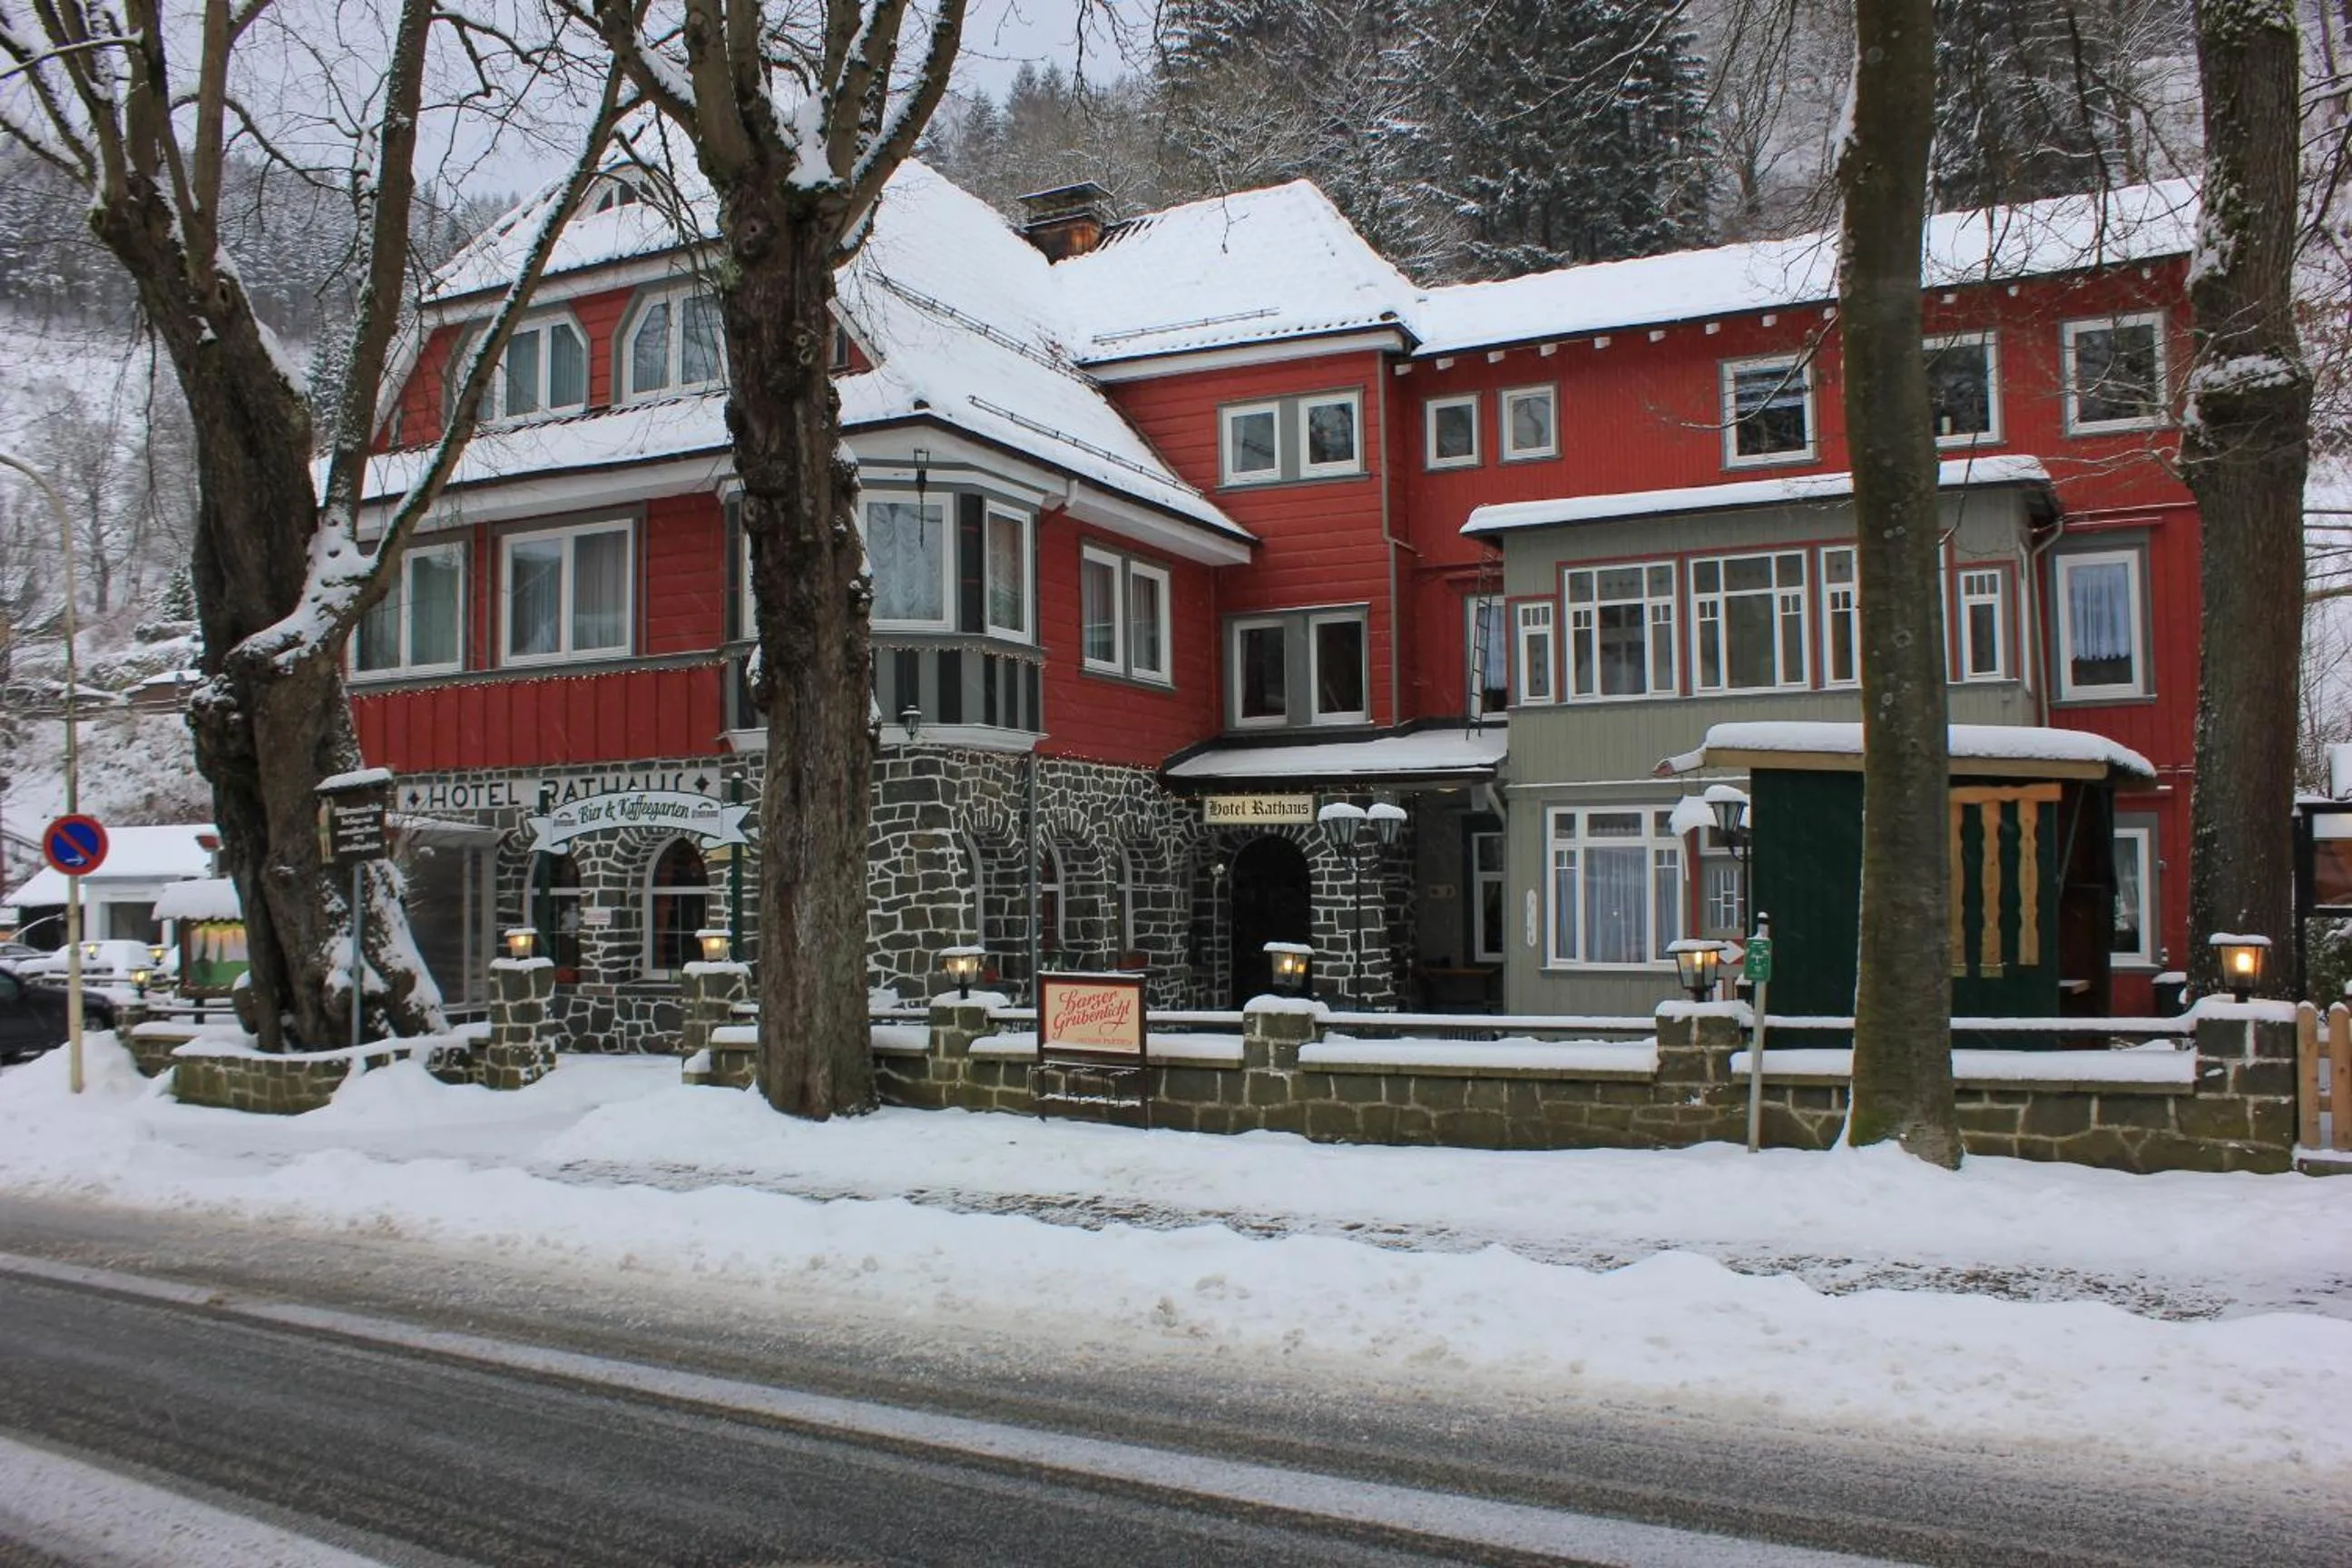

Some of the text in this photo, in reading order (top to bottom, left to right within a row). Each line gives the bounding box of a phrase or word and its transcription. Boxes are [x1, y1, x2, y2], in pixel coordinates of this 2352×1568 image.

[429, 781, 520, 808] HOTEL
[1209, 799, 1308, 817] Hotel Rathaus
[578, 802, 603, 824] Bier
[605, 800, 616, 820] &
[618, 795, 690, 820] Kaffeegarten
